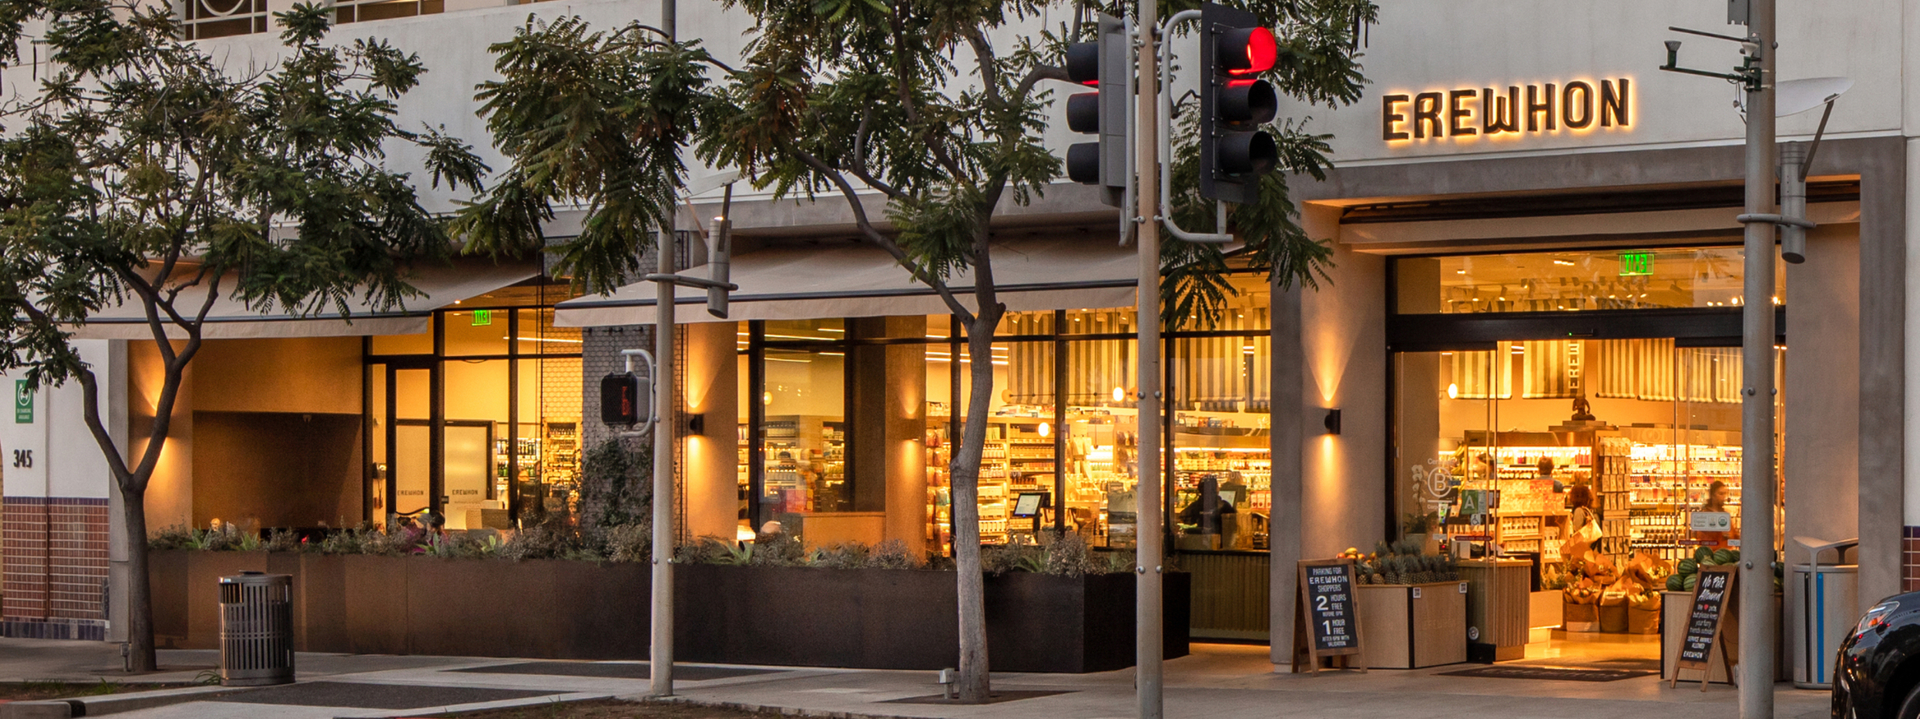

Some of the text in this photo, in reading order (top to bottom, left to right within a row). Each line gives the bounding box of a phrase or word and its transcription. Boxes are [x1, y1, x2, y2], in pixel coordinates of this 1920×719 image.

[1383, 78, 1629, 140] EREWHON
[13, 449, 33, 469] 345
[1464, 495, 1475, 510] A
[1313, 568, 1332, 576] PARKING
[1309, 575, 1348, 584] EREWHON
[1702, 574, 1725, 589] No Pets
[1318, 584, 1342, 592] SHOPPERS
[1697, 588, 1724, 602] Allowed
[1316, 594, 1347, 611] 2 HOURS
[1331, 602, 1343, 610] FREE
[1322, 620, 1331, 635] 1
[1333, 627, 1345, 635] FREE
